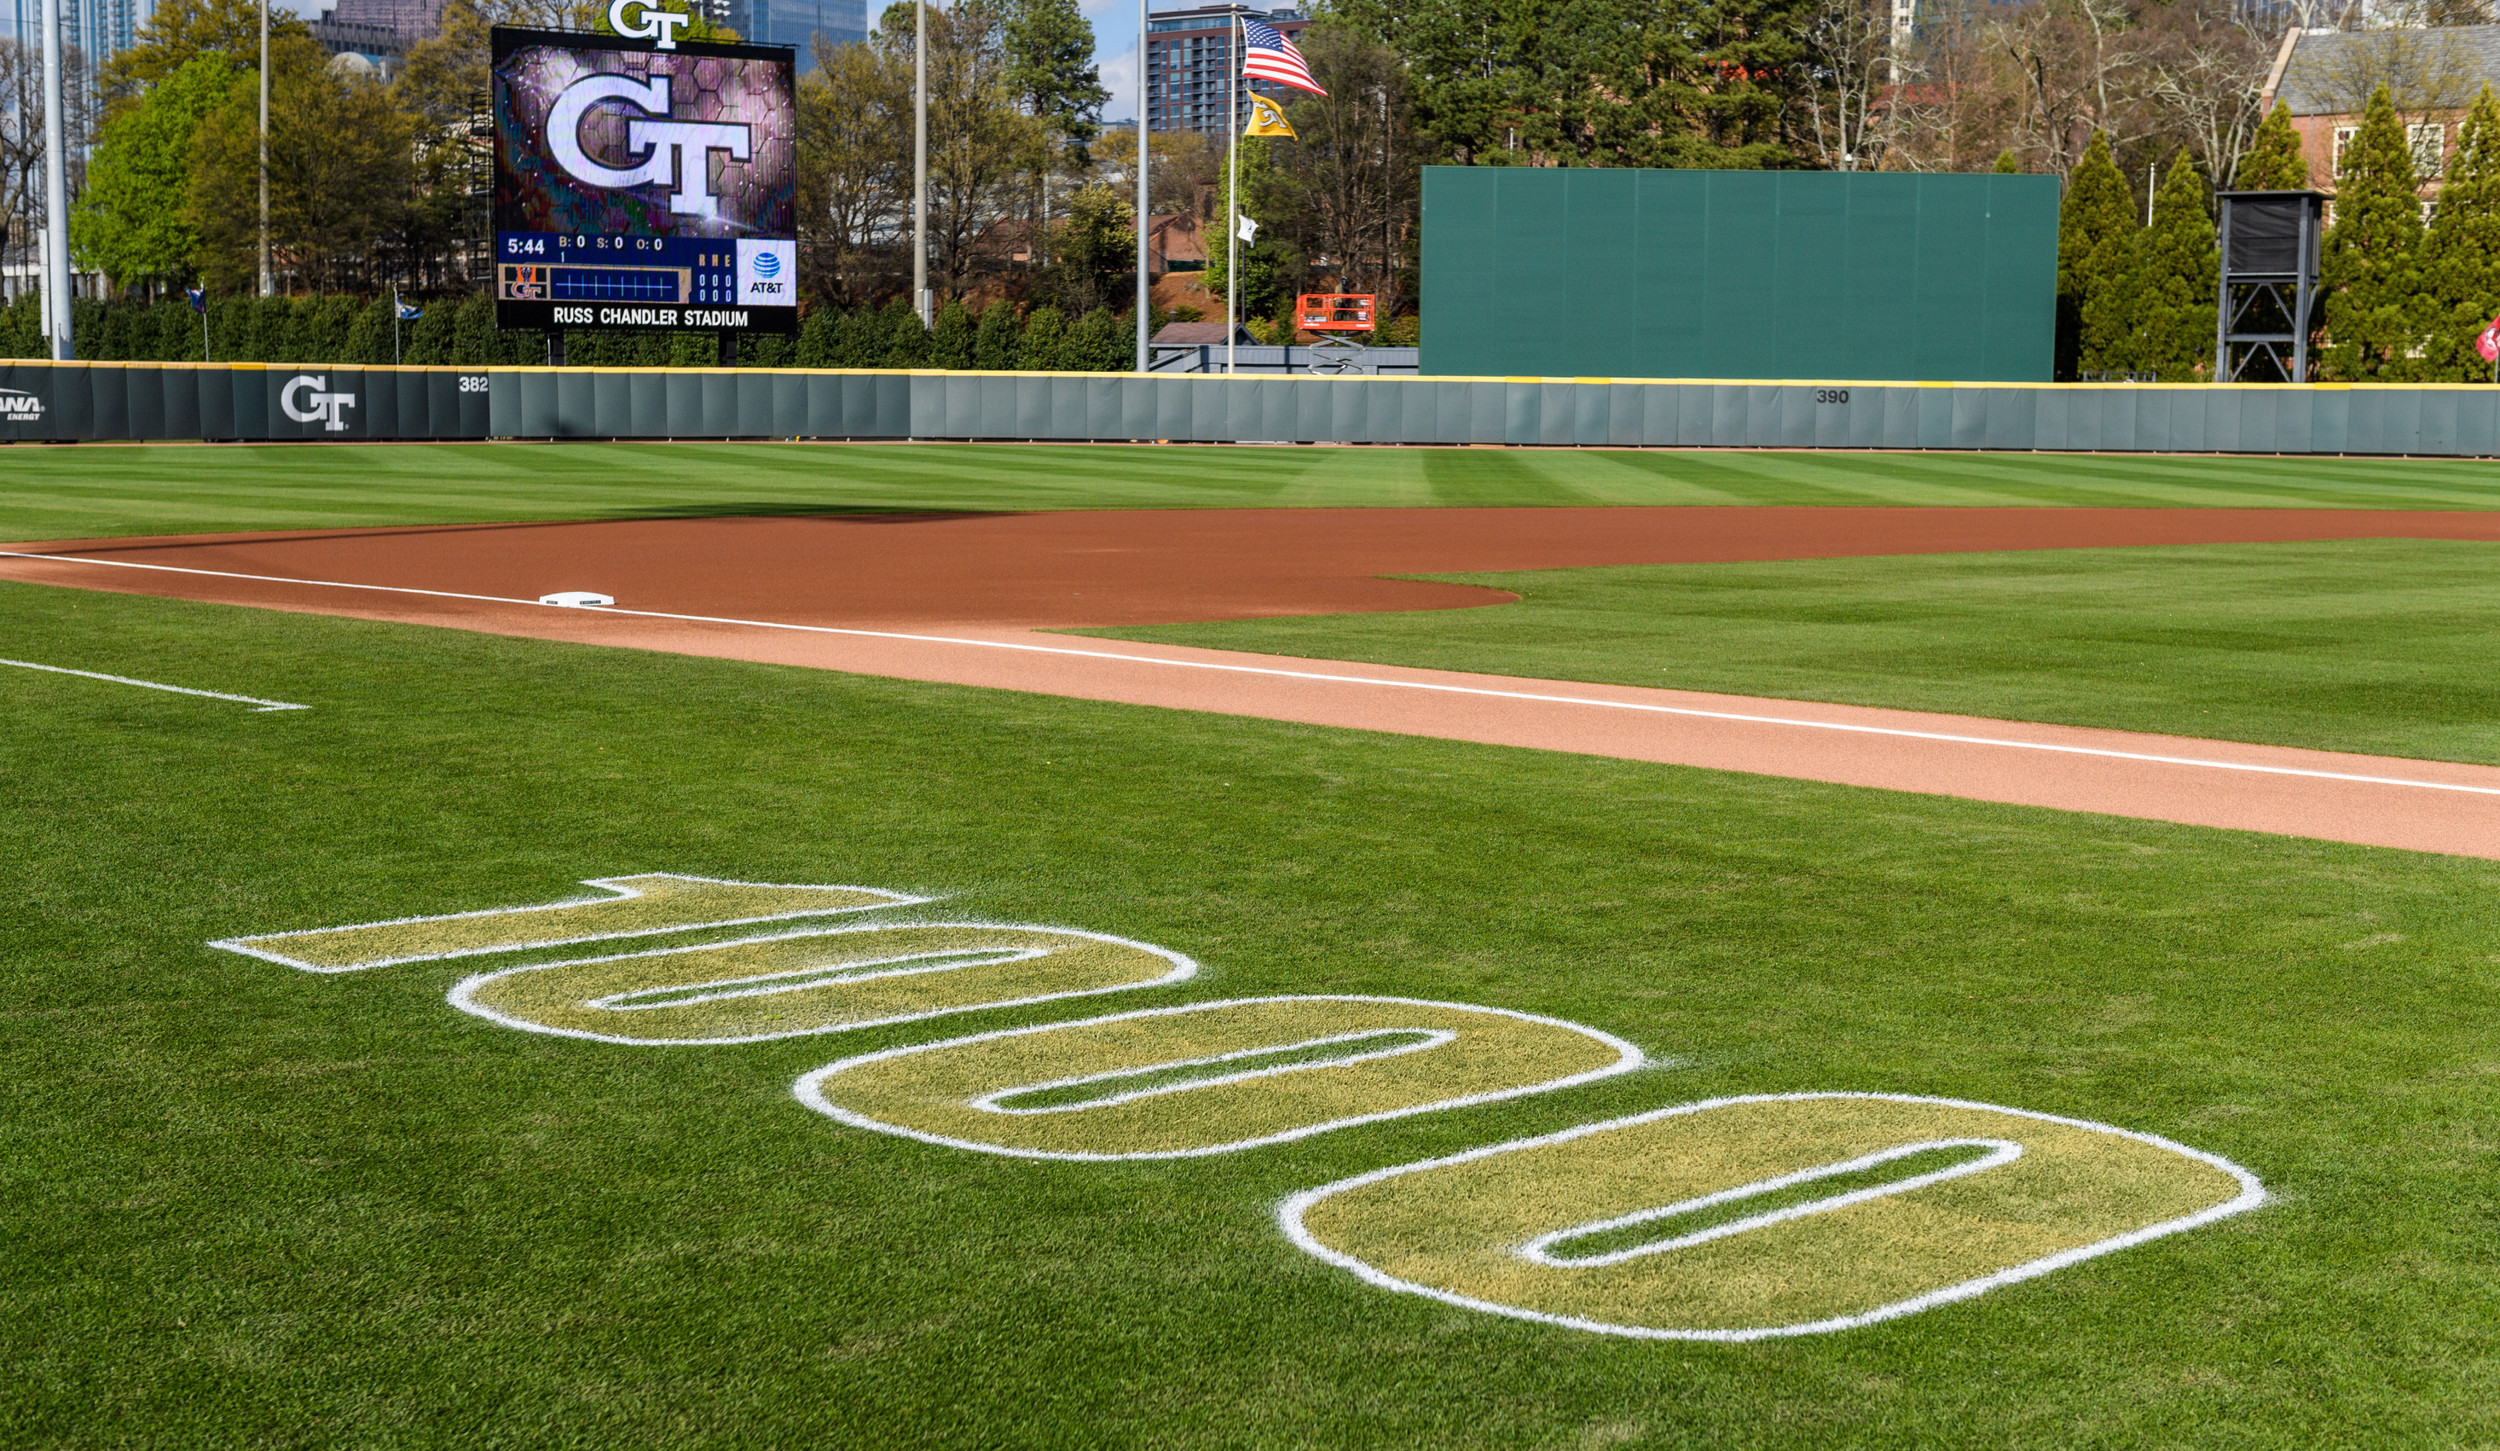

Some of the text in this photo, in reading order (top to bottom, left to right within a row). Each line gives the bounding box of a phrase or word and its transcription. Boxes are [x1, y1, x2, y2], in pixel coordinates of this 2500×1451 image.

[546, 73, 749, 216] GT
[508, 238, 545, 254] 5:44
[559, 236, 571, 247] B:
[576, 235, 585, 248] 0
[597, 237, 608, 248] S:
[614, 236, 623, 249] 0
[653, 238, 663, 250] 0
[725, 254, 731, 267] E
[700, 274, 731, 287] 0 0 0
[750, 282, 783, 293] AT&T
[700, 289, 731, 302] 0 0 0
[554, 307, 748, 327] RUSS CHANDLER STADIUM
[459, 376, 489, 392] 382
[281, 375, 355, 431] GT
[1817, 390, 1849, 404] 390
[7, 413, 40, 421] ENERGY
[208, 873, 2268, 1341] 1000
